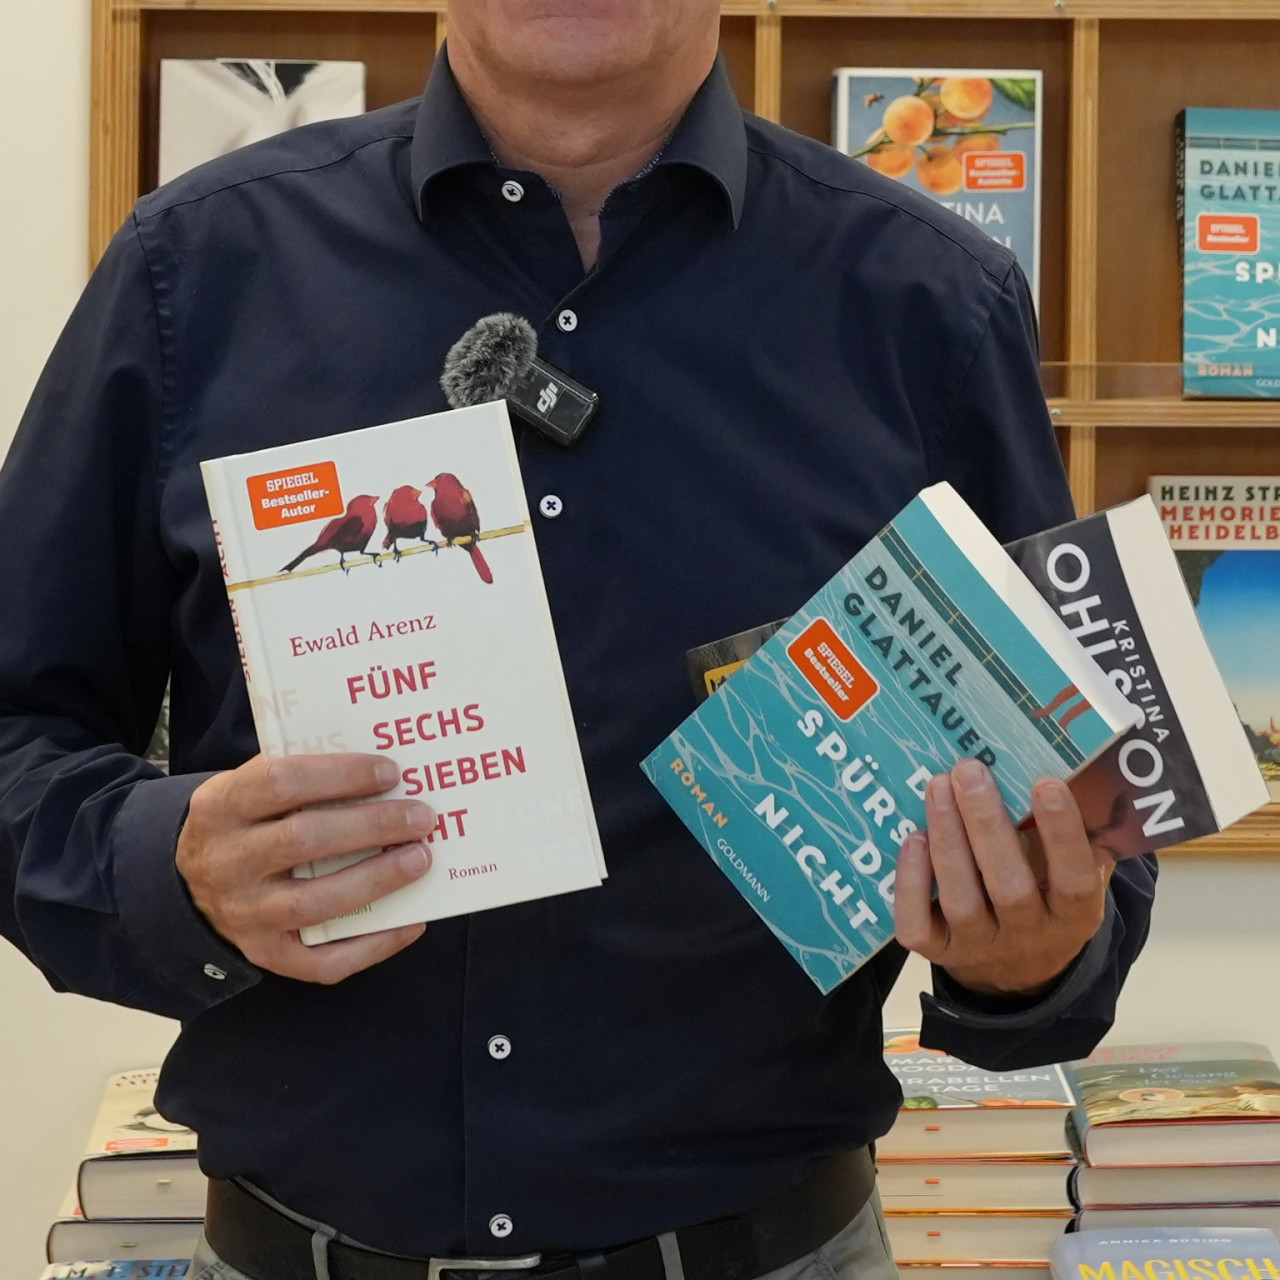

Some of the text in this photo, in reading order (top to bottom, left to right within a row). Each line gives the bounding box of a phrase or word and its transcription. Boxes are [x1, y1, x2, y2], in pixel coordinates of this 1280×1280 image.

[1197, 364, 1254, 377] ROMAN
[260, 488, 330, 509] Bestseller-
[265, 471, 319, 492] SPIEGEL
[1160, 485, 1235, 502] HEINZ
[280, 503, 316, 519] Autor
[289, 614, 437, 657] Ewald Arenz
[864, 565, 966, 688] DANIEL
[345, 660, 438, 705] FÜNF
[803, 647, 850, 703] Bestseller
[816, 641, 855, 689] SPIEGEL
[843, 592, 998, 767] GLATTAUER
[1111, 619, 1170, 744] KRISTINA
[1046, 542, 1186, 838] OHLON
[372, 702, 486, 751] SECHS
[401, 745, 527, 797] SIEBEN
[670, 758, 729, 828] ROMAN
[796, 709, 918, 847] SPÜRS
[448, 862, 498, 880] Roman
[716, 837, 771, 904] GOLDMANN
[754, 793, 879, 930] NICHT
[927, 1084, 1001, 1094] TAGE
[1078, 1256, 1280, 1280] MAGISCH
